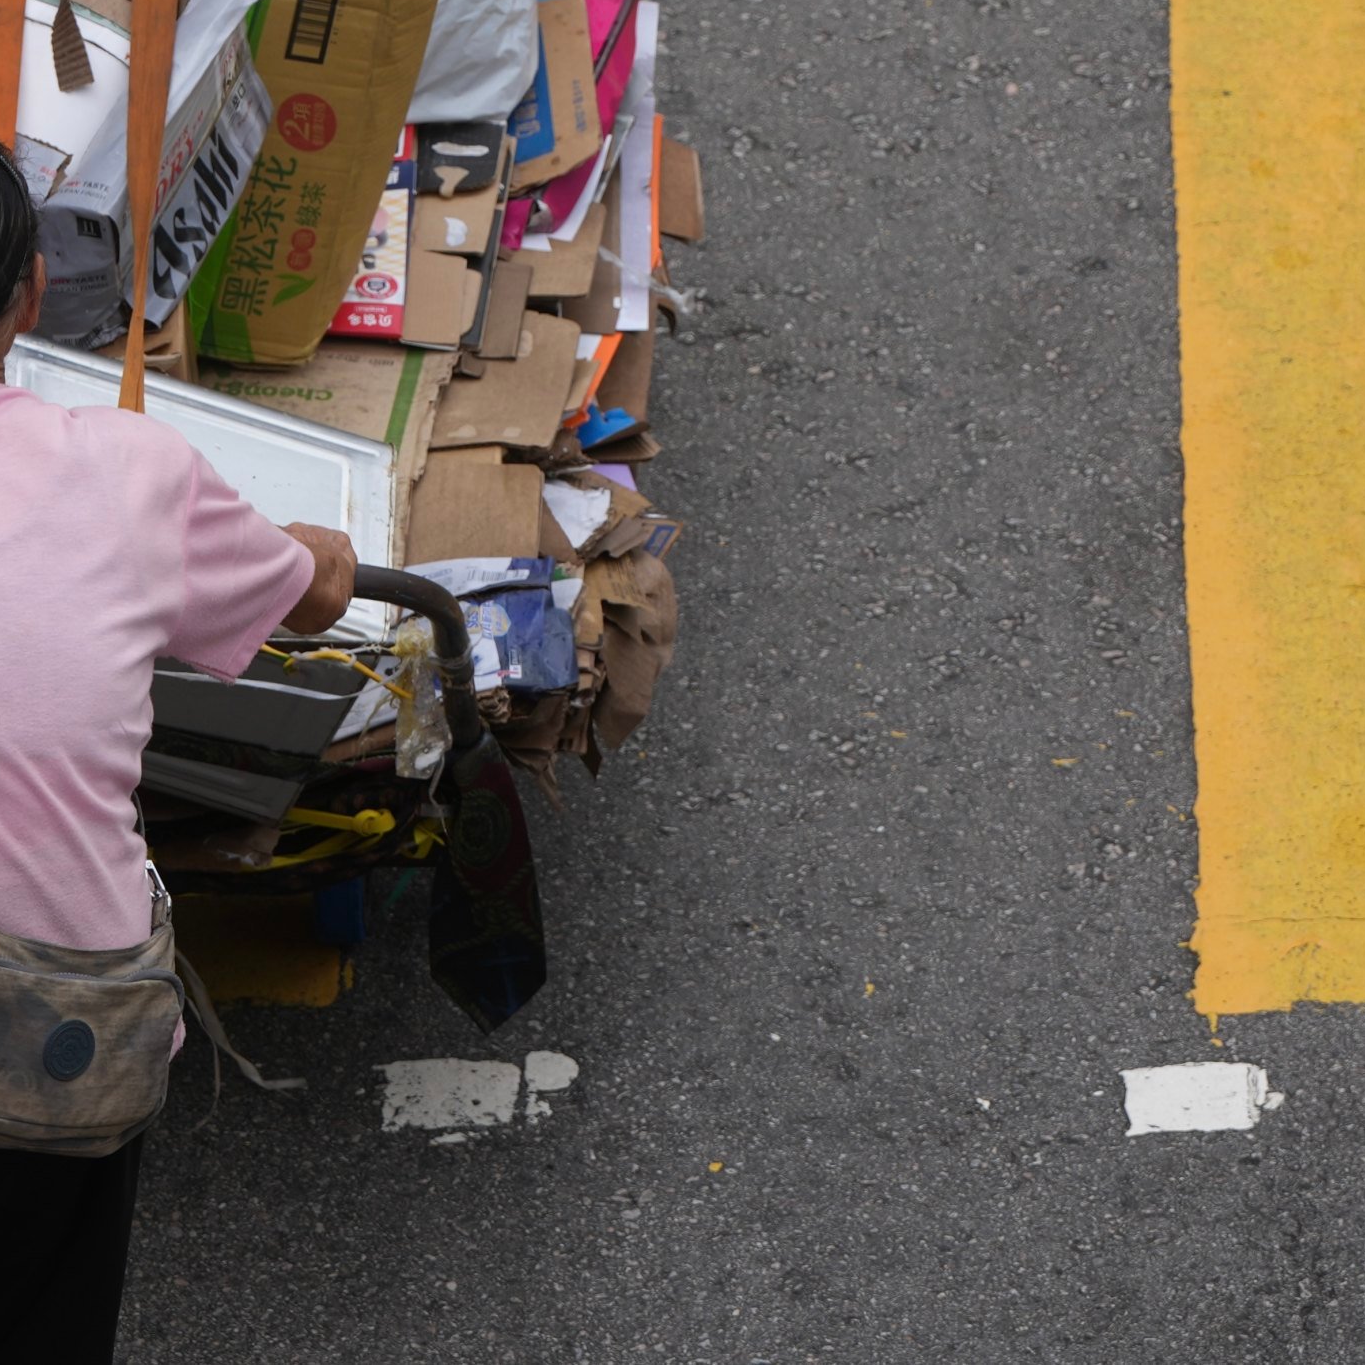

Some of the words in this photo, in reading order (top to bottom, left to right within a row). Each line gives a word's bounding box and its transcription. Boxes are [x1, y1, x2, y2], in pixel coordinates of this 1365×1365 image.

[50, 277, 71, 286] DRY
[75, 274, 108, 284] TASTE
[152, 127, 239, 299] Asahi
[220, 153, 298, 316] 黑松茶花
